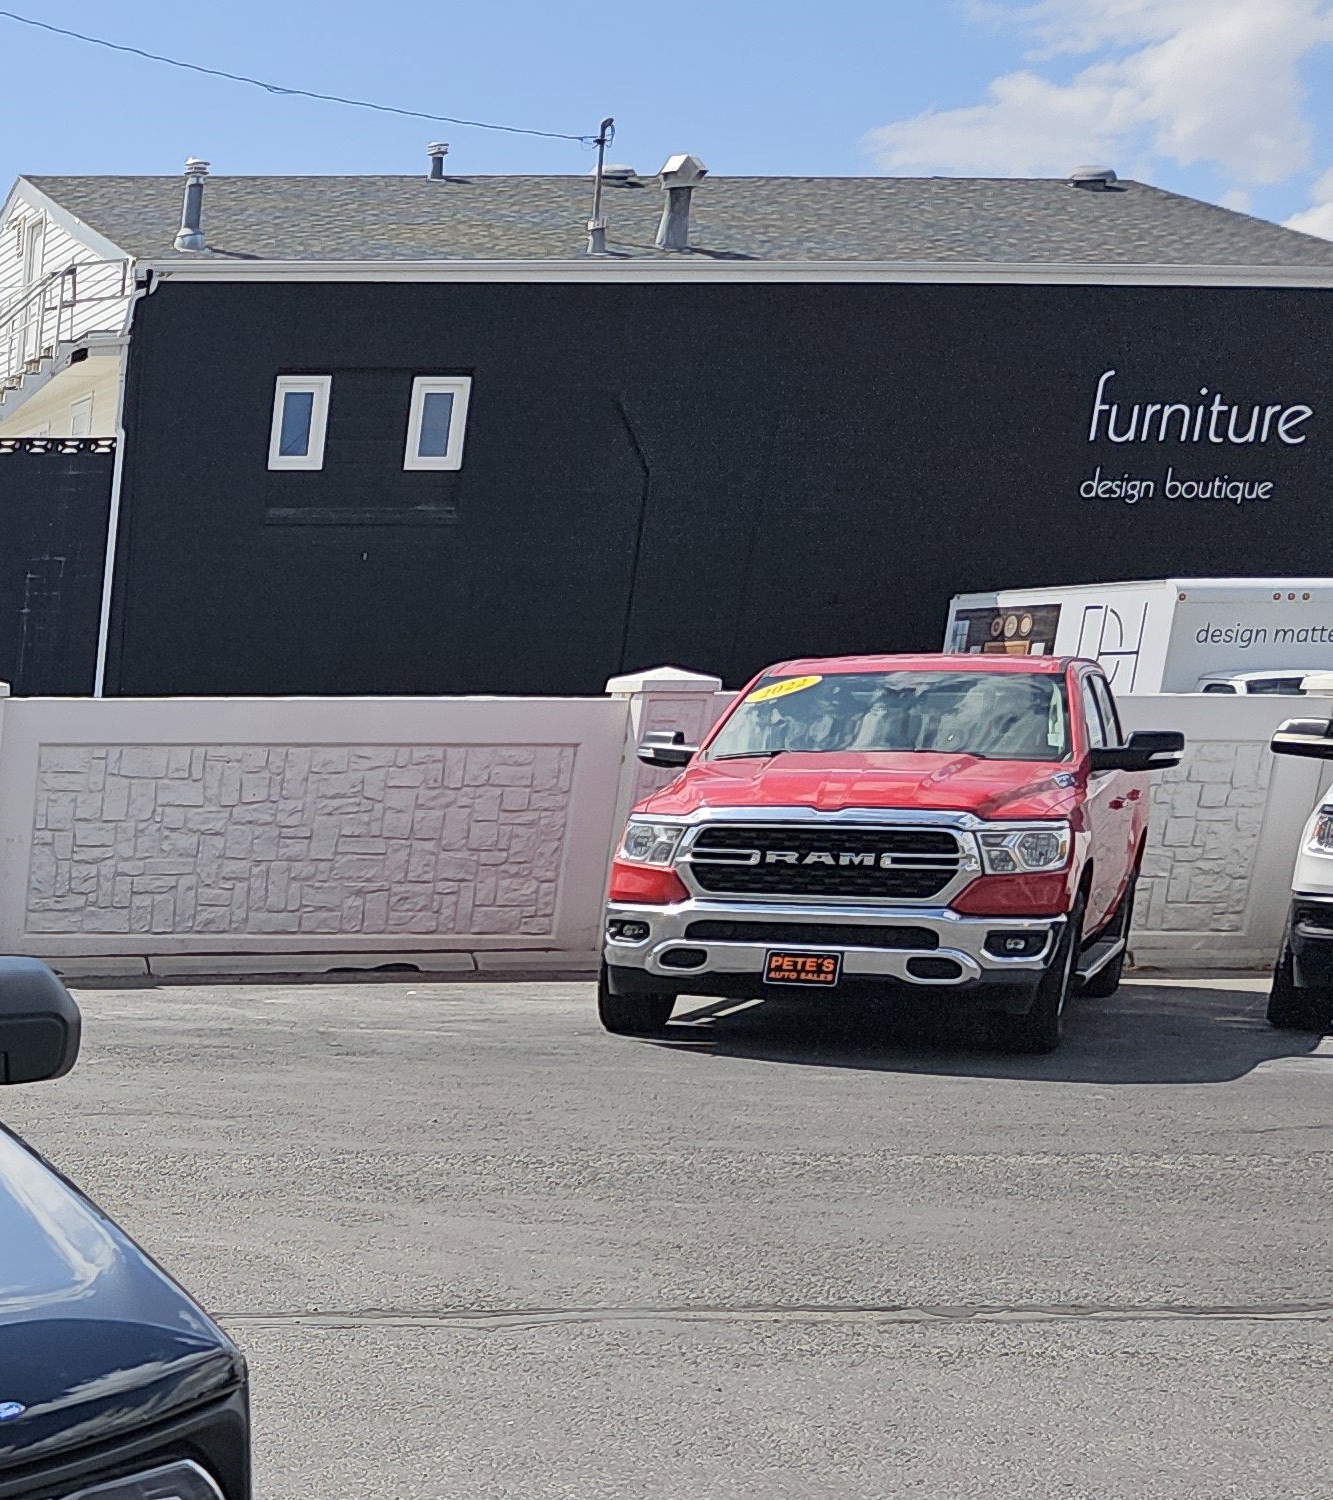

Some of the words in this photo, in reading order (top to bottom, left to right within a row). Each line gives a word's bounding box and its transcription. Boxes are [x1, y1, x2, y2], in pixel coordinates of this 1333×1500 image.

[1090, 369, 1313, 444] furniture
[1080, 467, 1154, 504] design
[1165, 467, 1273, 504] boutique
[1196, 622, 1267, 648] design
[765, 850, 876, 866] RAM
[770, 956, 835, 972] PETE'S
[769, 970, 796, 980] AUTO
[800, 972, 833, 981] SALES
